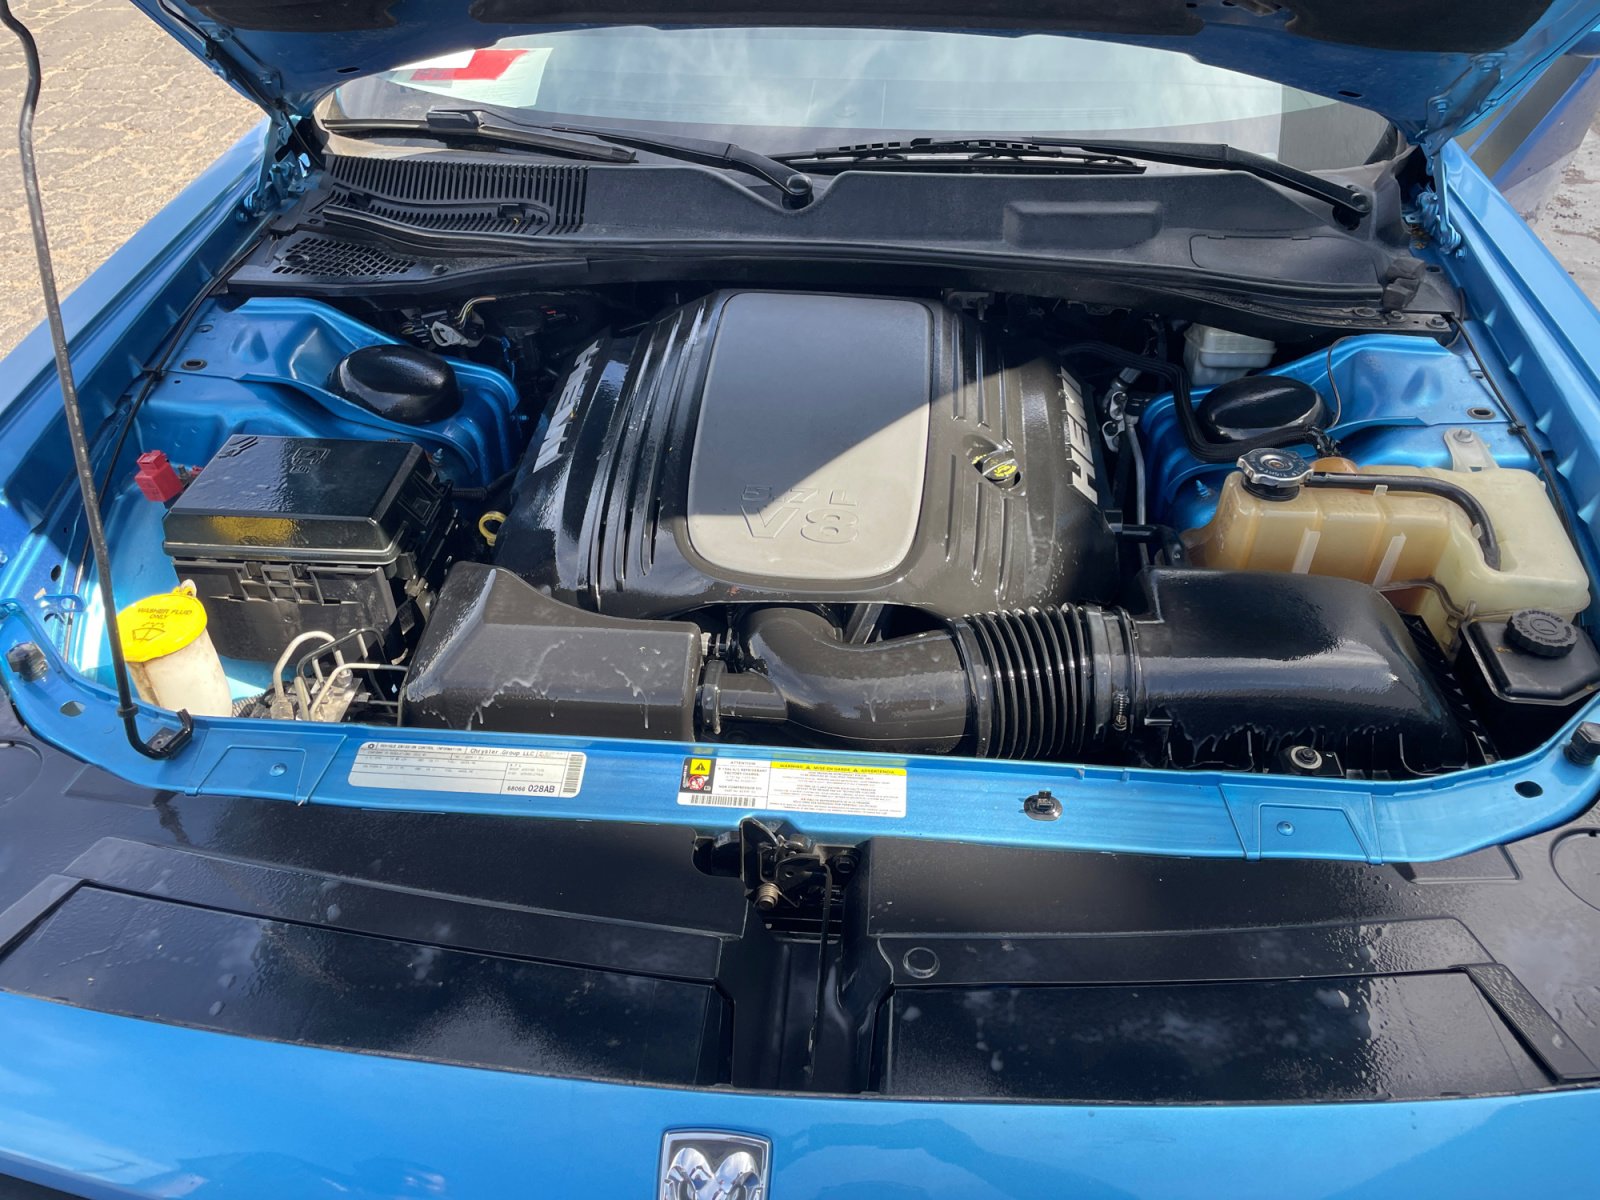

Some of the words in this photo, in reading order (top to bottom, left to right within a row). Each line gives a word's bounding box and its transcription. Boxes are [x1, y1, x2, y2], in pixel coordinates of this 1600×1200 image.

[533, 339, 600, 474] HEMI
[1059, 366, 1098, 505] HEMI
[740, 505, 860, 545] V8
[470, 748, 498, 756] Chrysler
[501, 749, 521, 757] Group
[527, 784, 555, 794] 028AB
